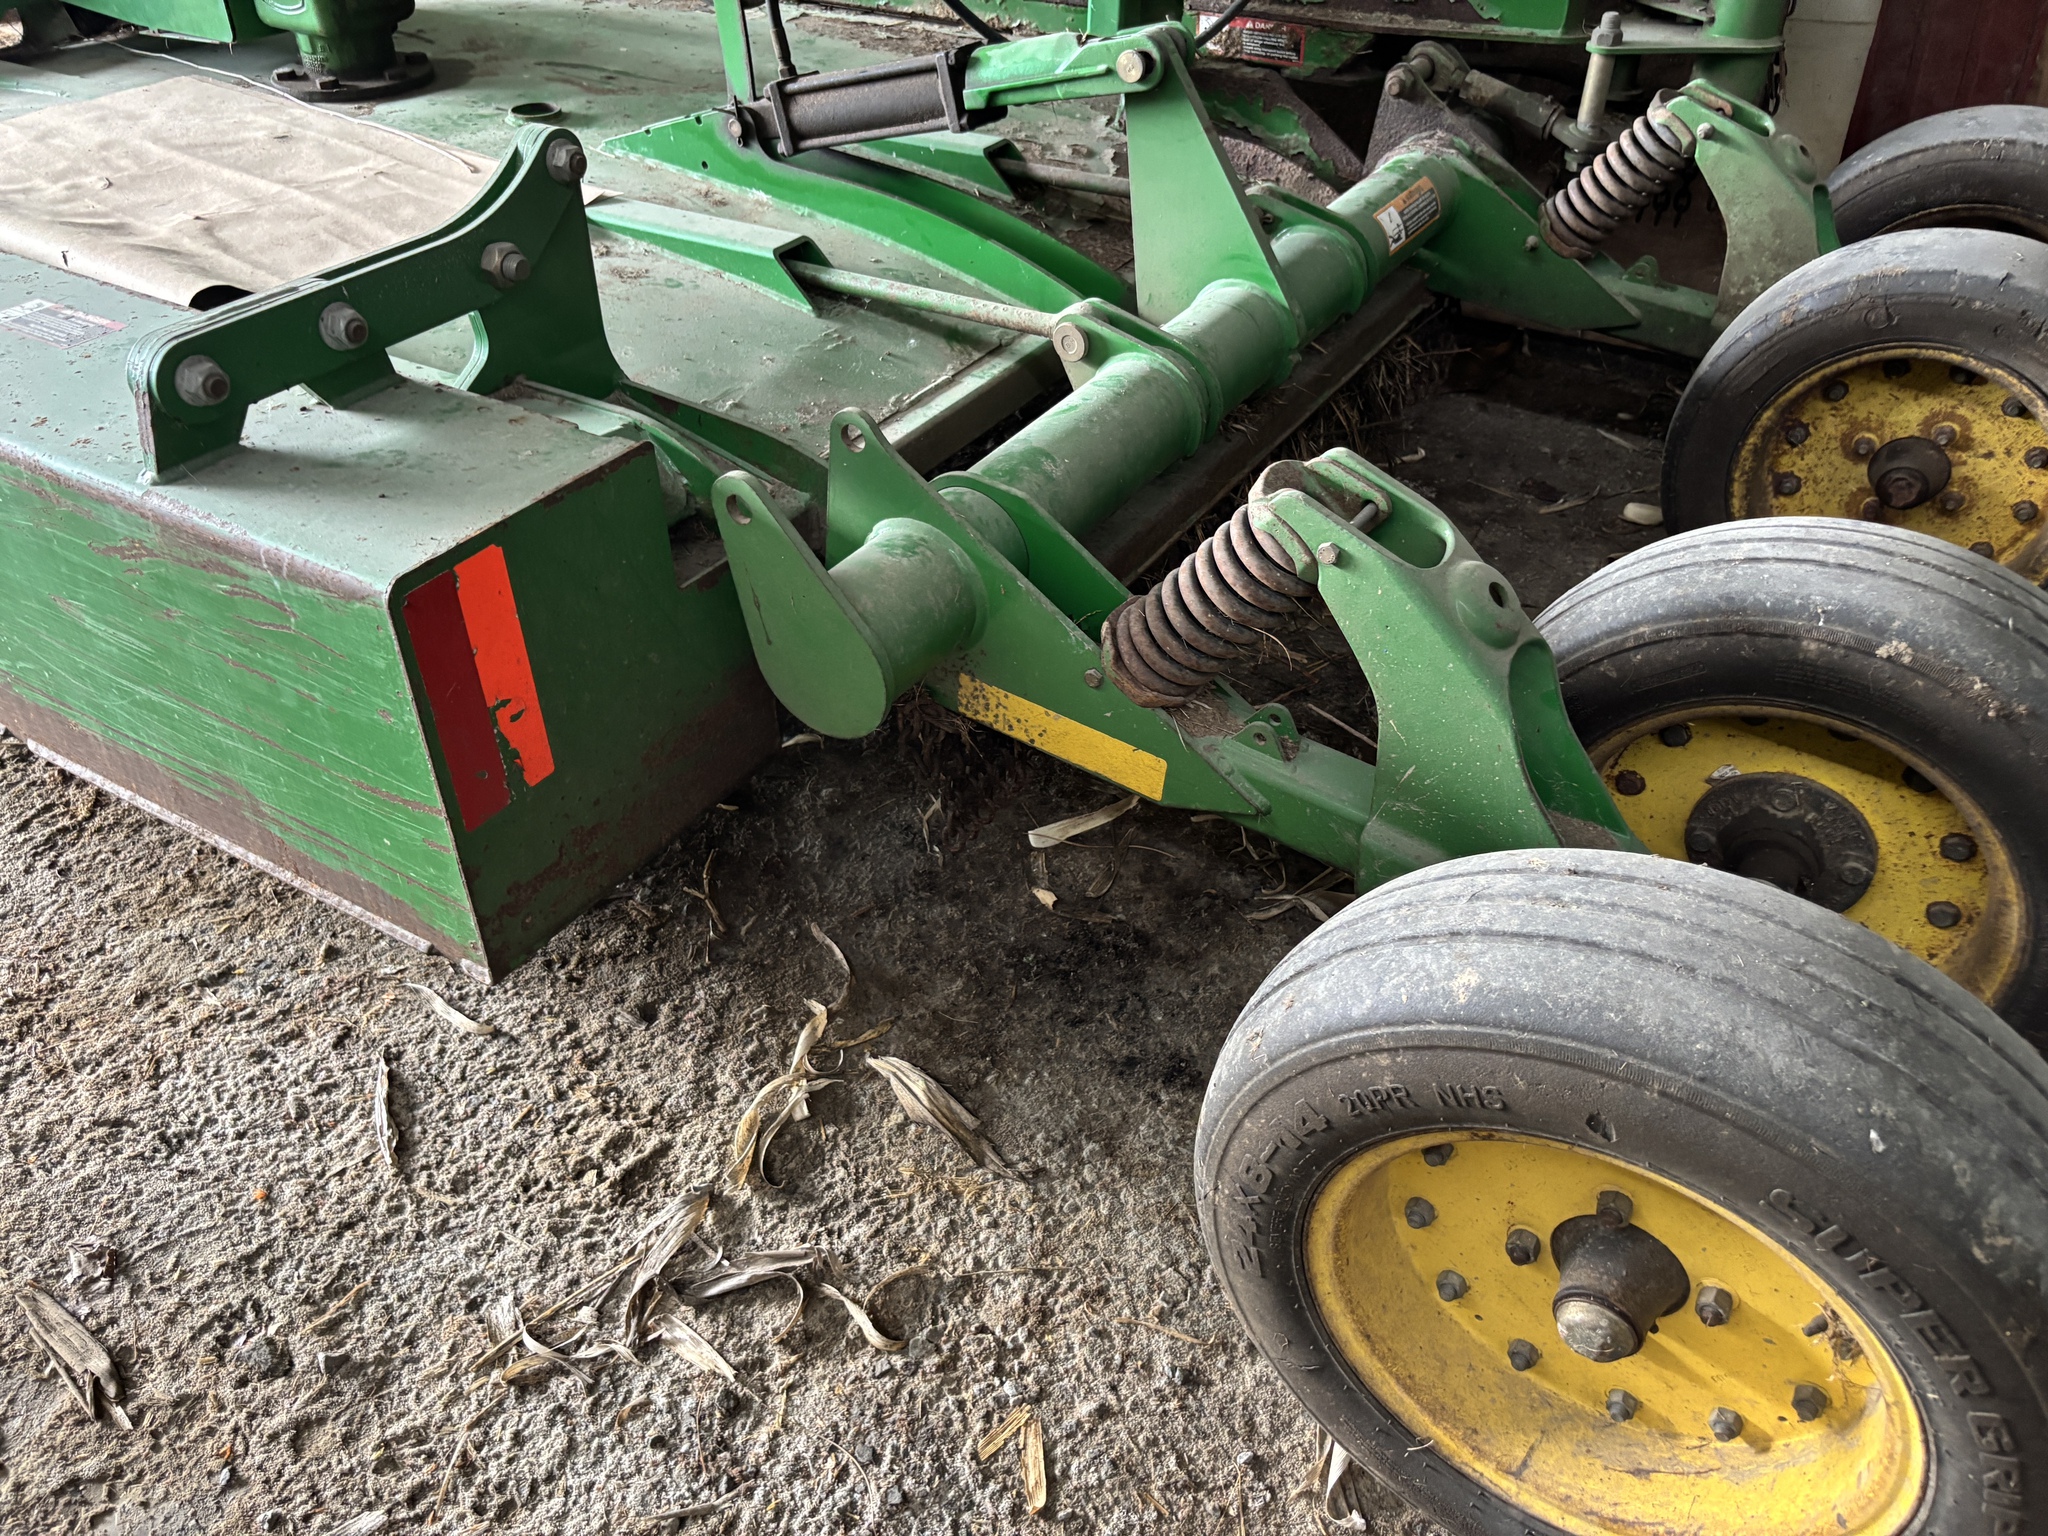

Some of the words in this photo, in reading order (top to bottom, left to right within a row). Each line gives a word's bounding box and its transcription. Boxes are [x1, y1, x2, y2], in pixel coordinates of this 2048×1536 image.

[1338, 1083, 1420, 1117] 20PR
[1431, 1082, 1506, 1111] NHS
[1758, 1187, 1992, 1399] SUPER
